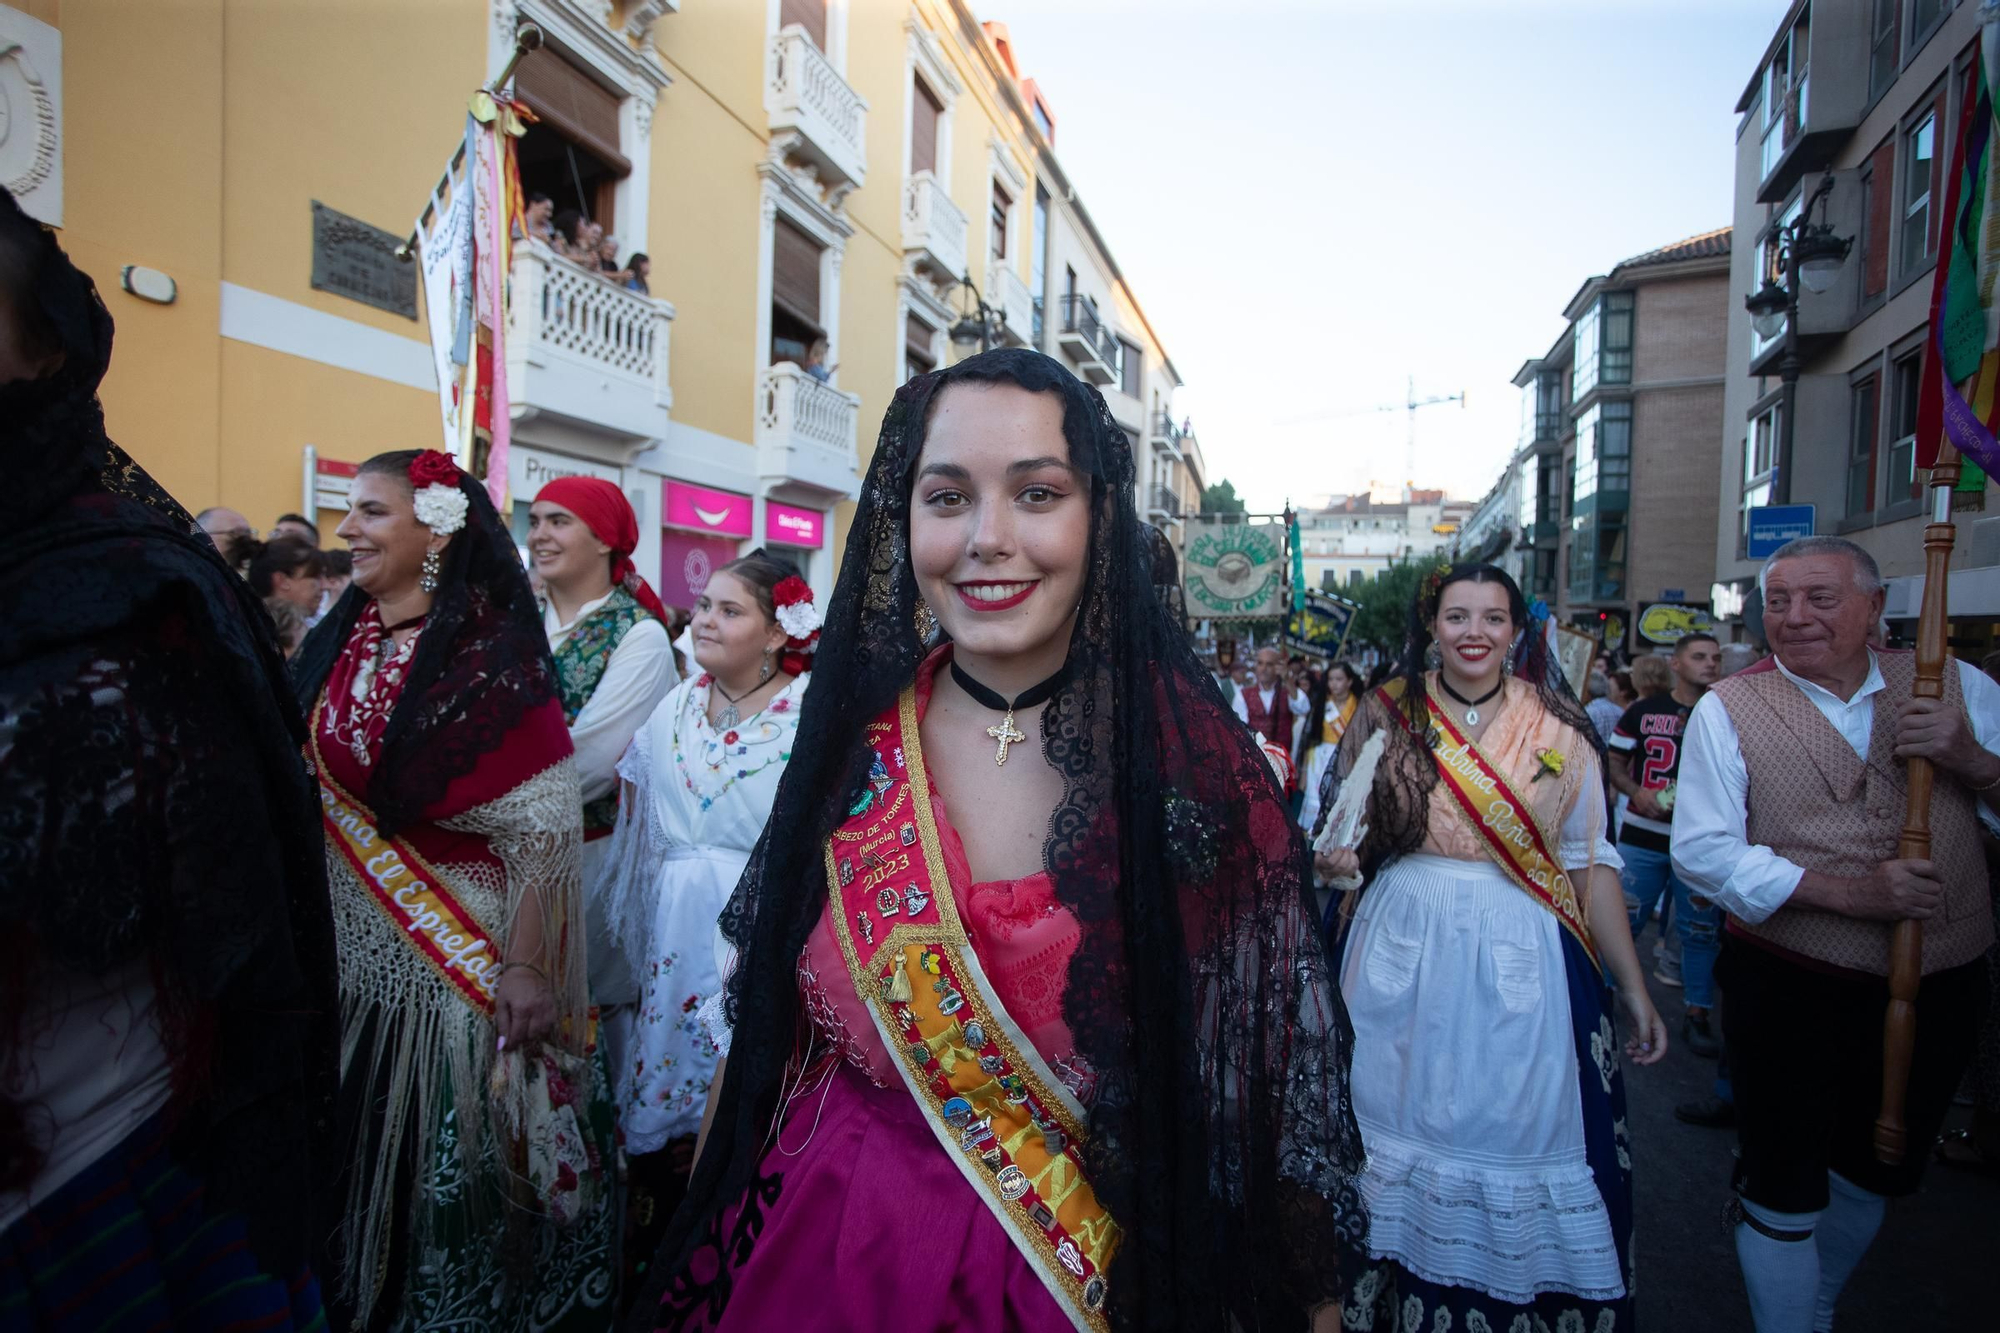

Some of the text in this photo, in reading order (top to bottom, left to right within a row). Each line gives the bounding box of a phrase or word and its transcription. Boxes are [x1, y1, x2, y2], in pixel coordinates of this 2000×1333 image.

[867, 823, 881, 838] DE
[881, 783, 910, 825] TORRES
[1482, 800, 1534, 849] Peña
[365, 850, 406, 890] El
[862, 853, 911, 895] 2023
